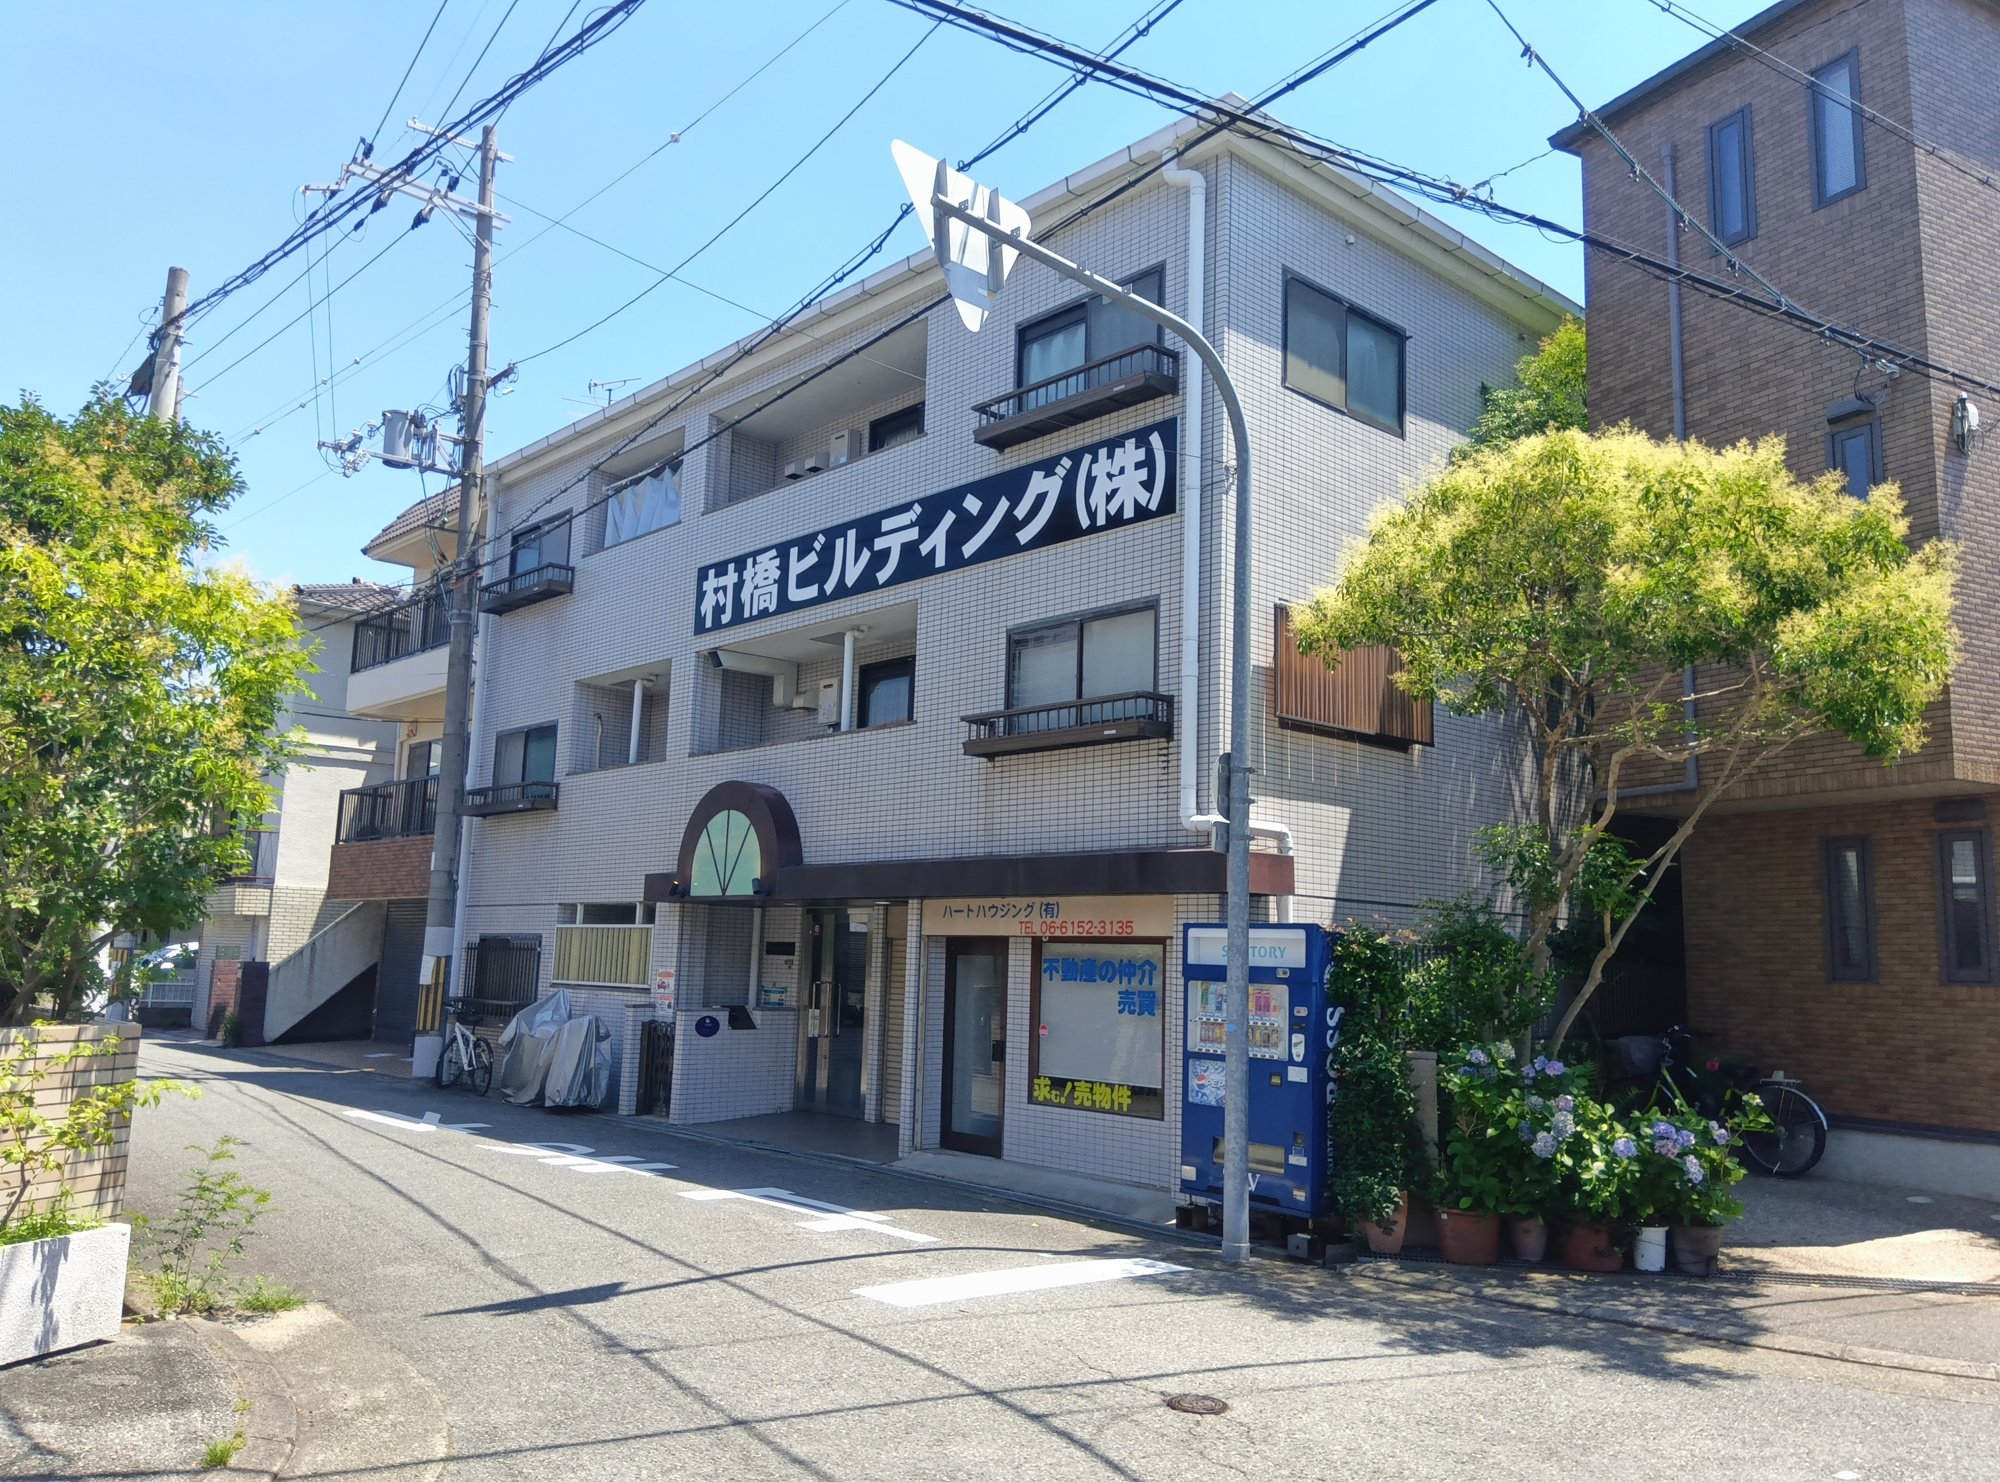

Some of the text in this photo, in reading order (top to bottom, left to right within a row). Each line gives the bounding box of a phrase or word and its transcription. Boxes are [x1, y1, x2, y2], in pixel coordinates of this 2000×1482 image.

[700, 430, 1166, 628] 村橋ビルディング(株)
[1018, 920, 1134, 935] TEL 06-6152-3135
[1222, 945, 1287, 959] STORY
[1042, 957, 1158, 985] 不動産の仲介
[1117, 989, 1157, 1017] 売買
